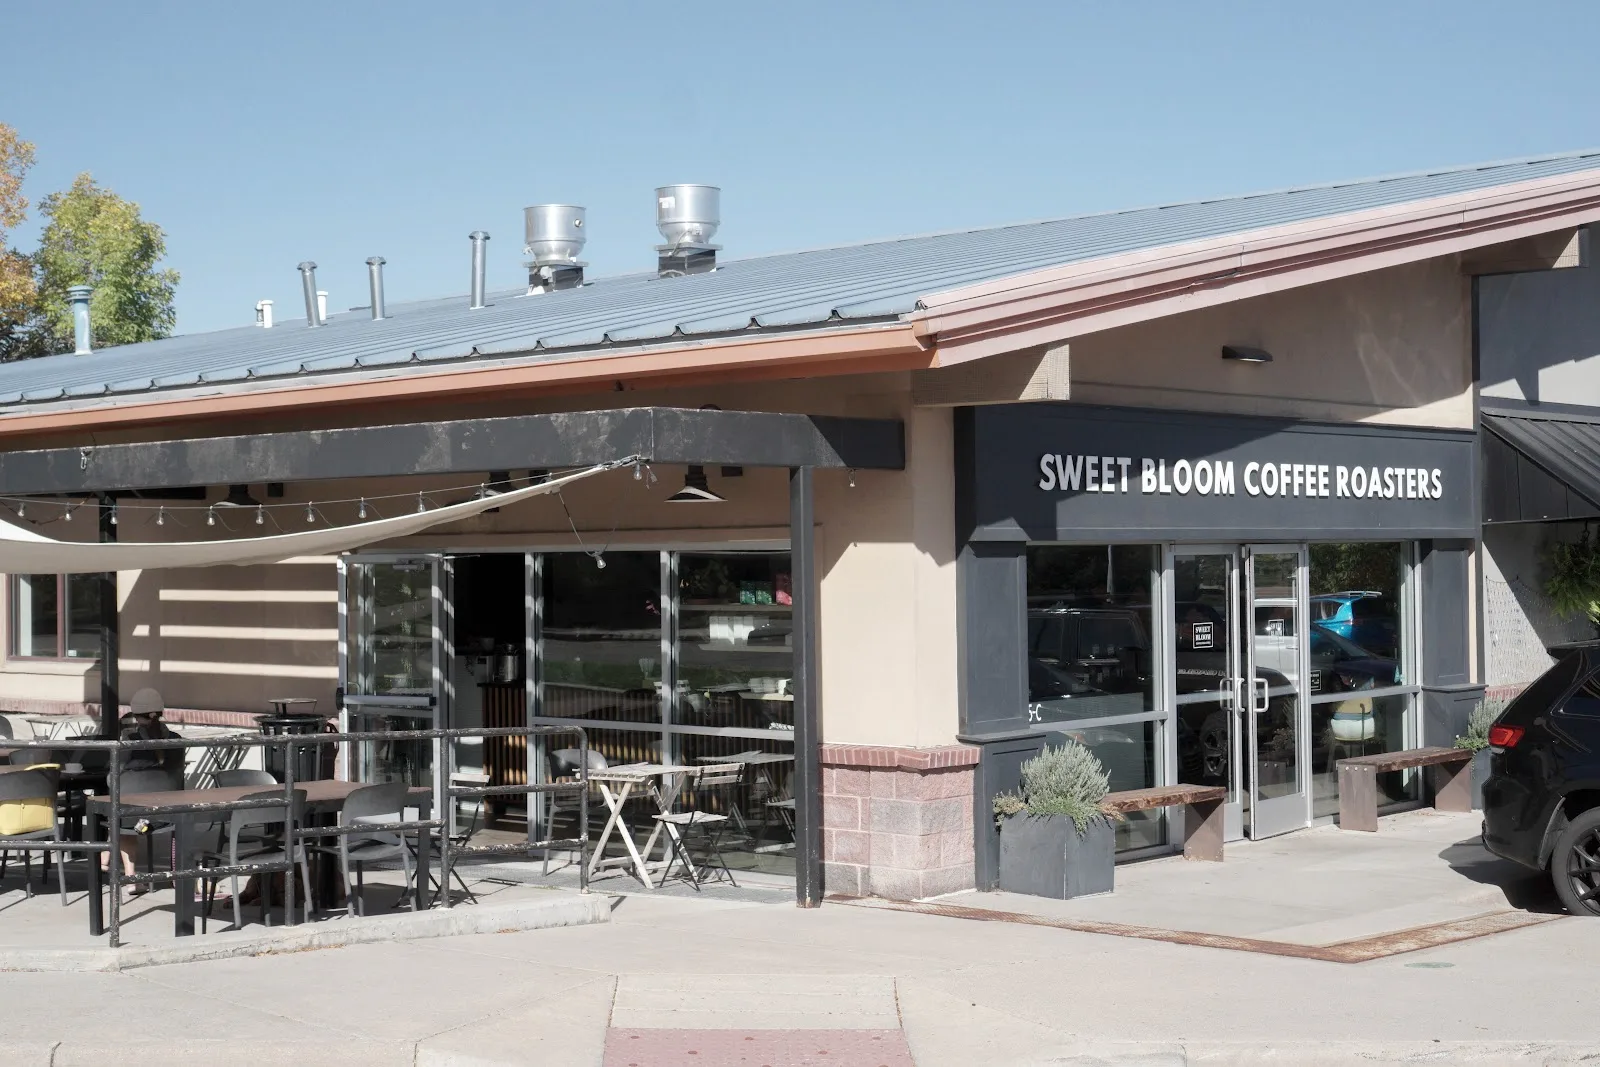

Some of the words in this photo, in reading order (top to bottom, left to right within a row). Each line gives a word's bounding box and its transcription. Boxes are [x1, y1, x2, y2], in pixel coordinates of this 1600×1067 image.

[1038, 453, 1132, 494] SWEET
[1140, 457, 1236, 496] BLOOM
[1243, 461, 1331, 498] COFFEE
[1336, 465, 1443, 500] ROASTERS
